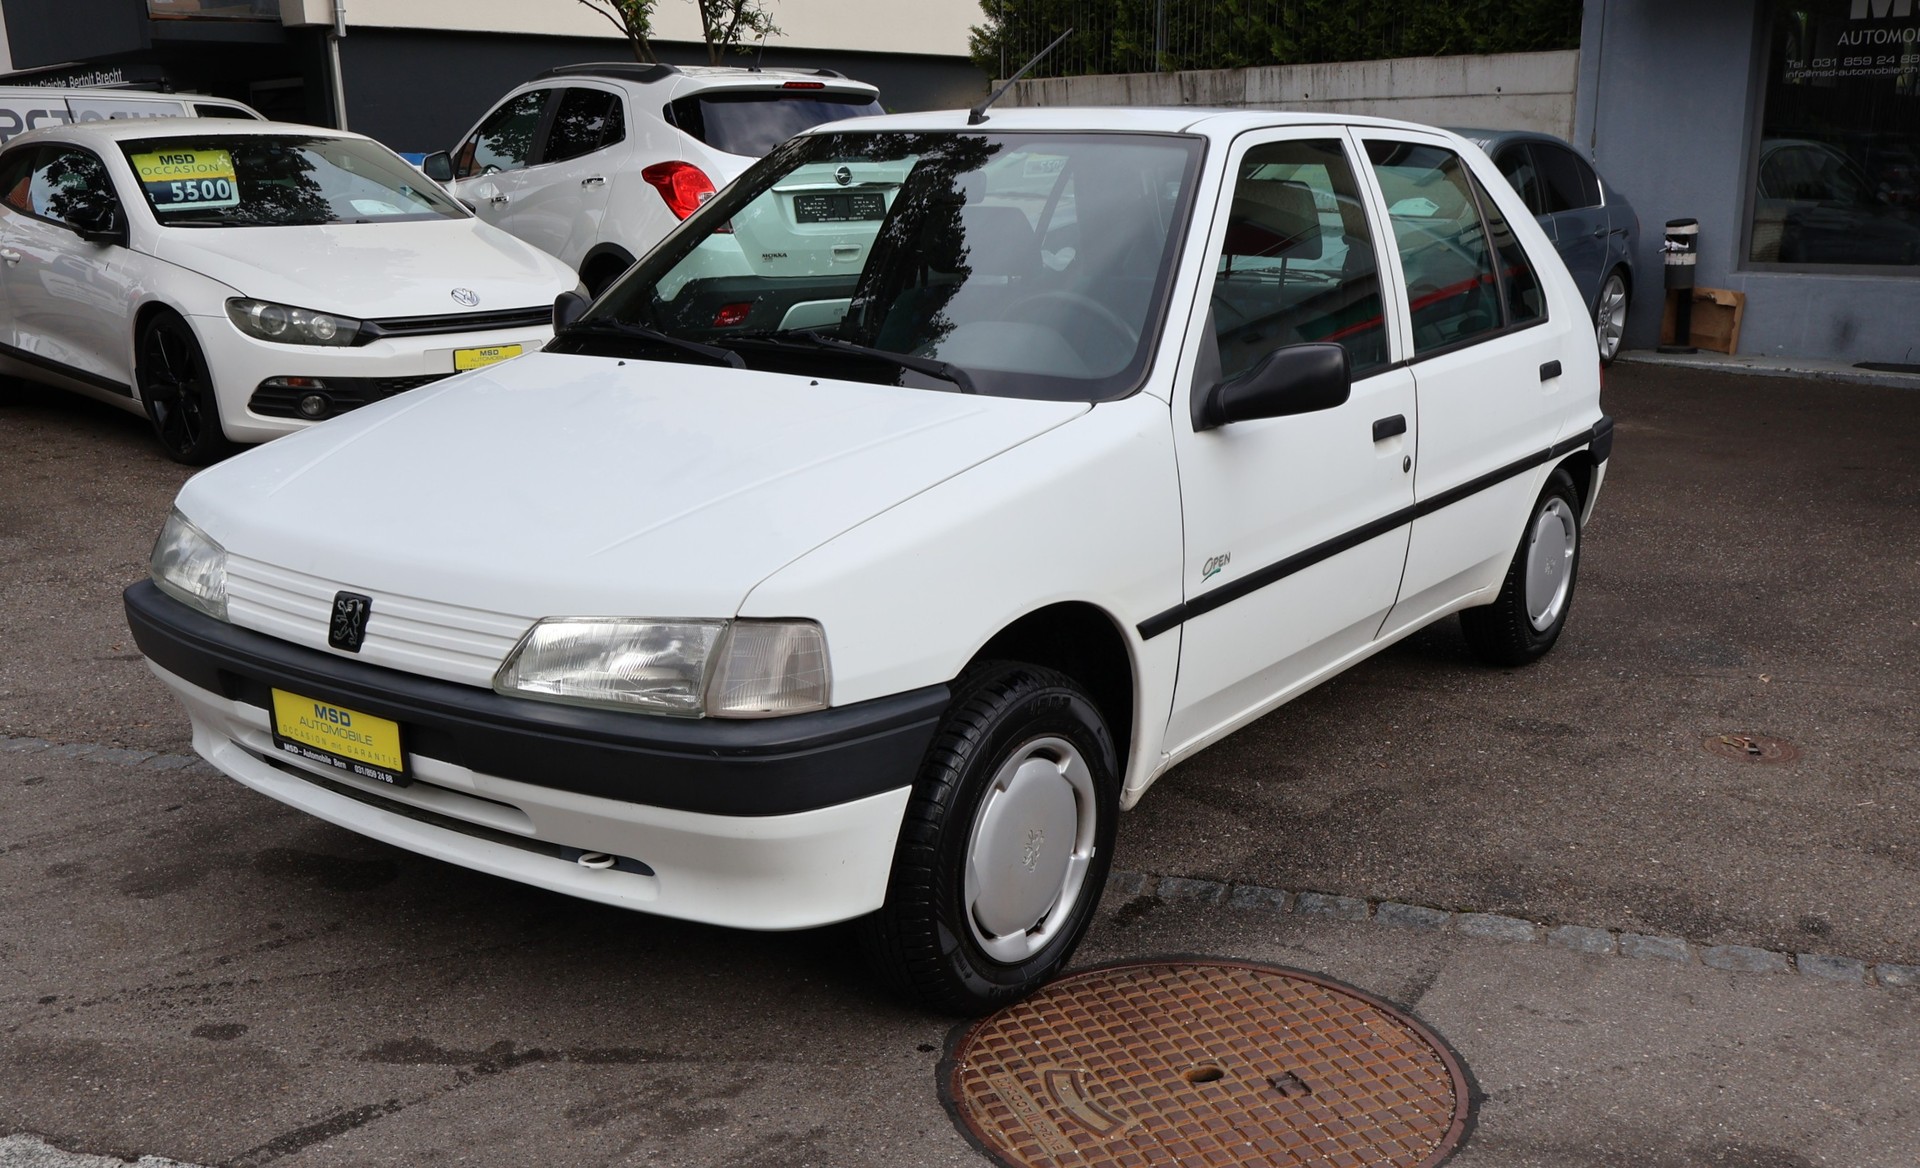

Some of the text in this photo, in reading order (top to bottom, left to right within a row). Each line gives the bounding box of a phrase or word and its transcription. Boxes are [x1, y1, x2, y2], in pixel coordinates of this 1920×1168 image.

[1837, 28, 1920, 45] AUTOMO
[1812, 58, 1837, 67] 031
[1843, 56, 1872, 66] 859
[1876, 55, 1896, 65] 24
[95, 67, 123, 85] Brecht
[158, 153, 196, 166] MSD
[141, 164, 218, 175] OCCASION
[170, 179, 230, 201] 5500
[314, 703, 351, 727] MSD
[300, 716, 373, 746] AUTOMOBILE
